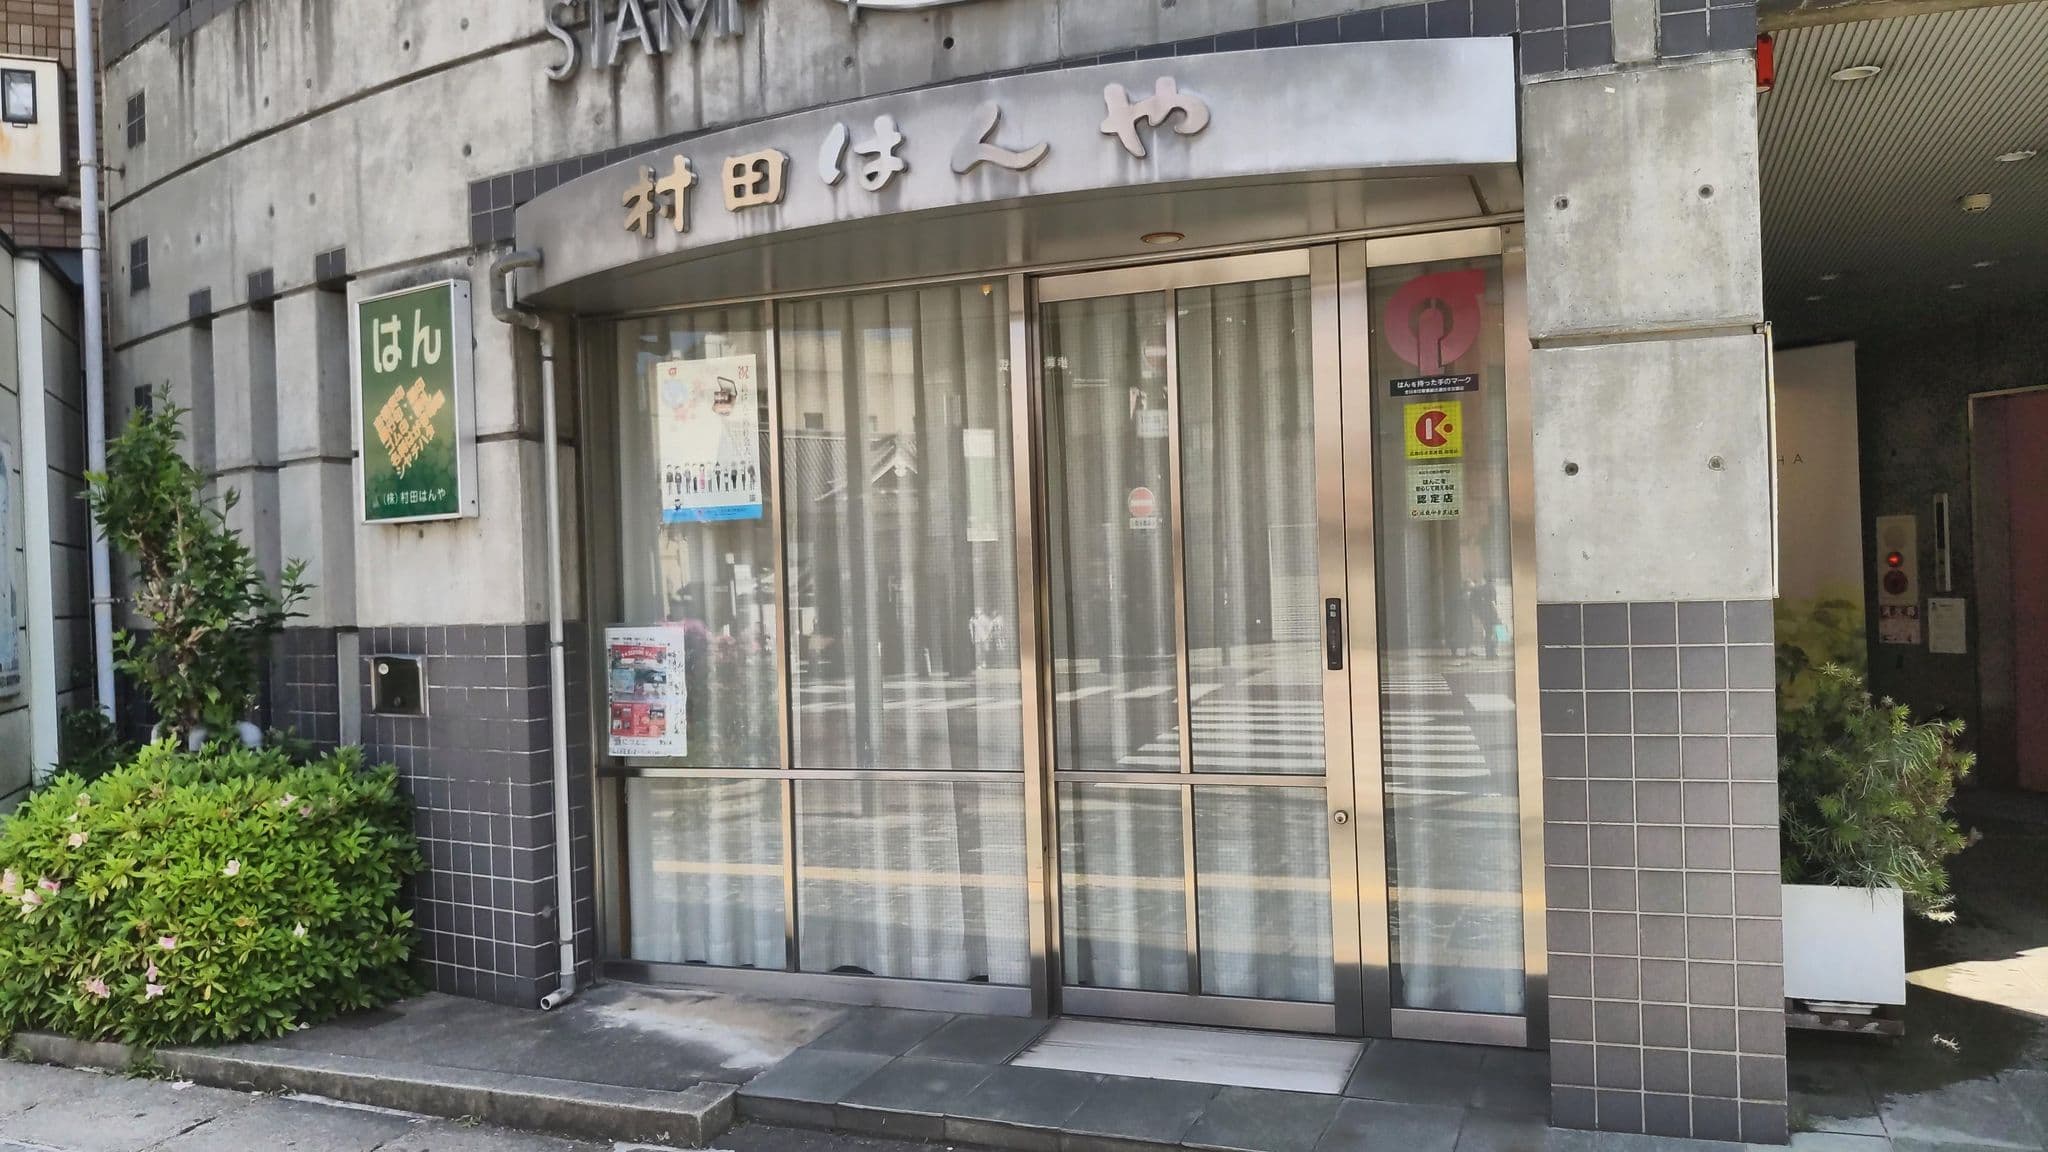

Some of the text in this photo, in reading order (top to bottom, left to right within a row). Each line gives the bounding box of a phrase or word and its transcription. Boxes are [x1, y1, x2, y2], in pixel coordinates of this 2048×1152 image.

[621, 77, 1211, 240] 村田はんや
[372, 308, 442, 374] はん
